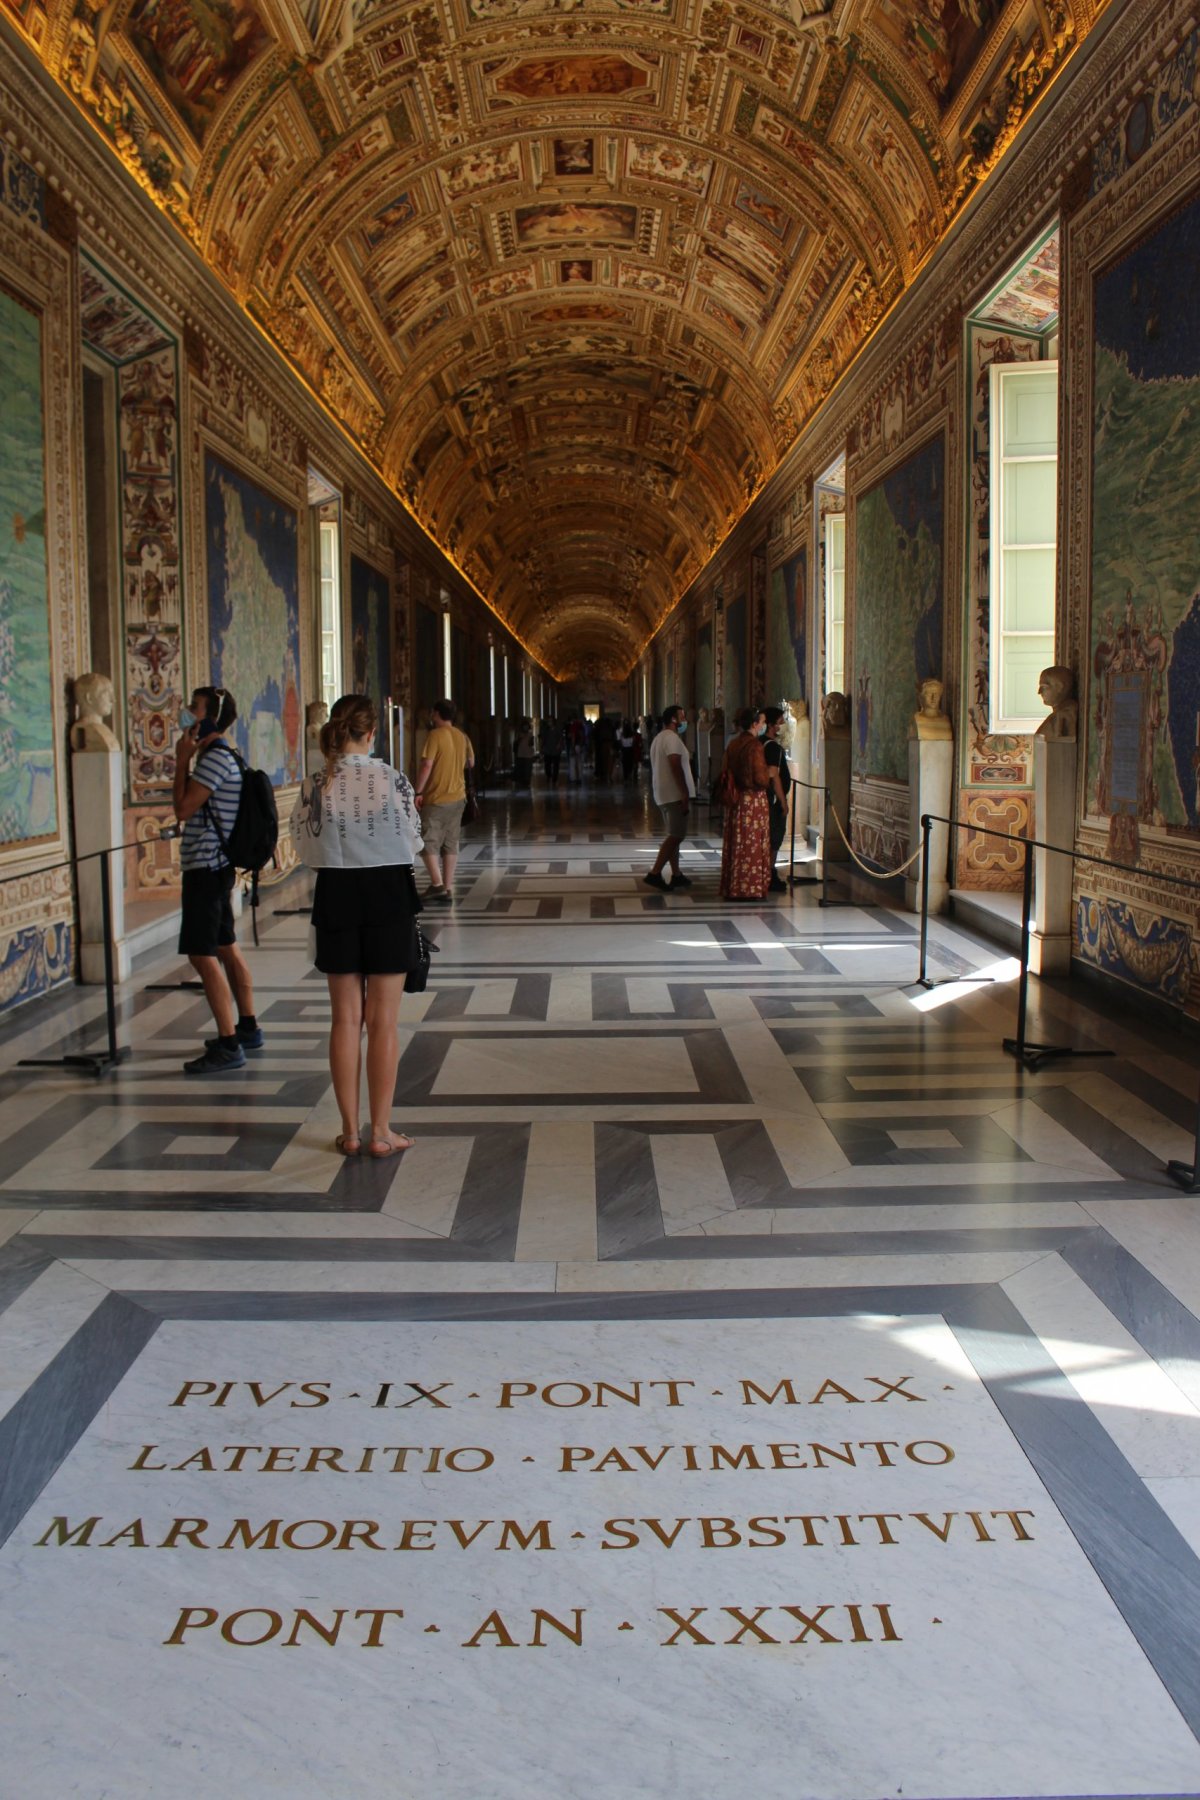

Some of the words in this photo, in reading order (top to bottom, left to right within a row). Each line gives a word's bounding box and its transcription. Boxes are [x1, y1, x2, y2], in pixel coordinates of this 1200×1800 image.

[168, 1381, 331, 1408] PIVS
[370, 1382, 454, 1409] IX
[495, 1381, 696, 1409] PONT
[738, 1376, 927, 1406] MAX
[127, 1444, 495, 1473] LATERITIO
[557, 1440, 955, 1471] PAVIMENTO
[33, 1516, 556, 1551] MARMOREVM
[601, 1510, 1035, 1550] SVBSTITVIT
[162, 1607, 404, 1648] PONT
[460, 1608, 587, 1648] AN
[656, 1603, 904, 1647] XXXII
